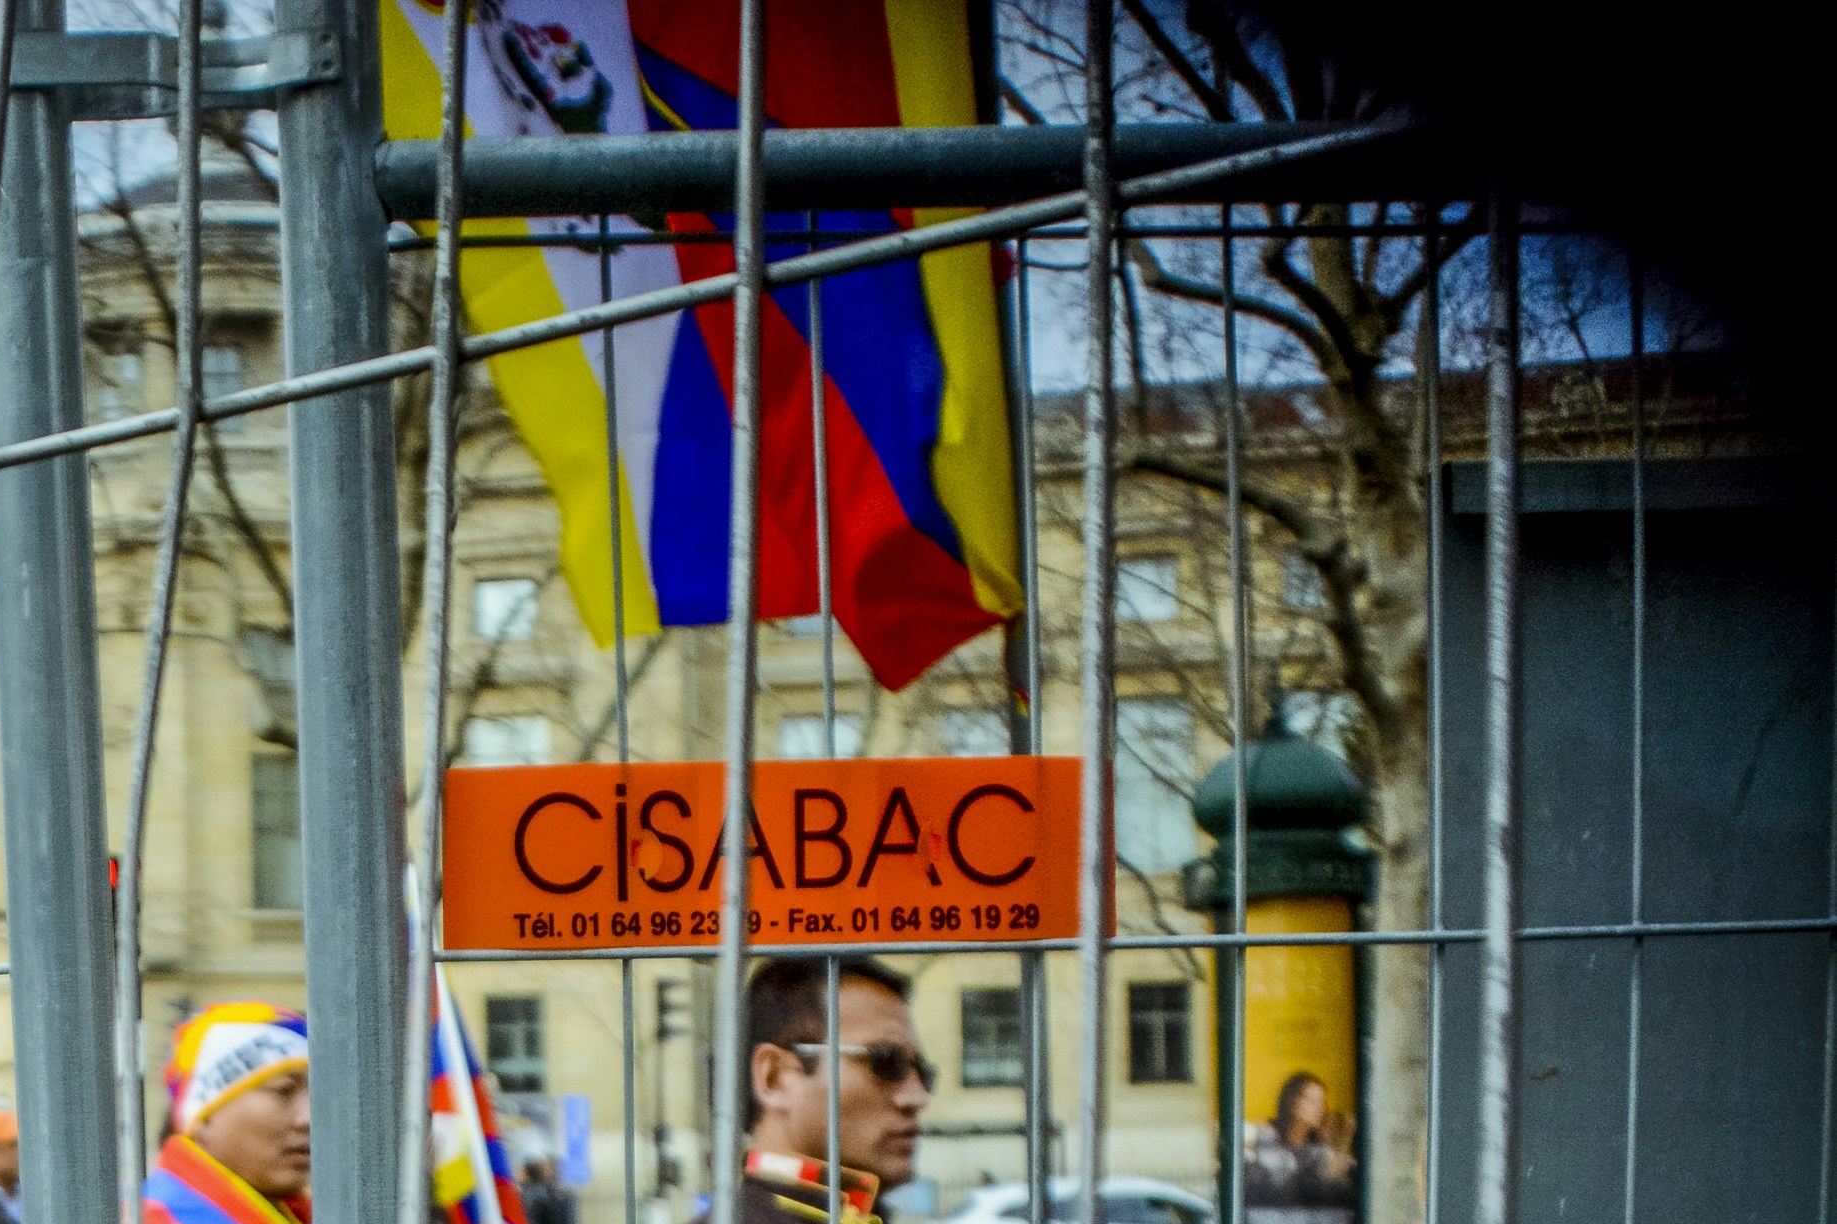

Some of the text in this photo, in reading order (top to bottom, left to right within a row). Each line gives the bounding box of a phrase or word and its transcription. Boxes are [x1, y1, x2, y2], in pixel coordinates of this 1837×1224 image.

[513, 911, 563, 938] Tél.
[571, 912, 600, 938] 01
[610, 911, 642, 936] 64
[650, 911, 682, 936] 96
[690, 910, 719, 935] 23
[788, 908, 844, 933] Fax.
[852, 907, 880, 932] 01
[890, 906, 921, 932] 64
[930, 905, 961, 931] 96
[970, 904, 1002, 930] 19
[1009, 903, 1040, 929] 29
